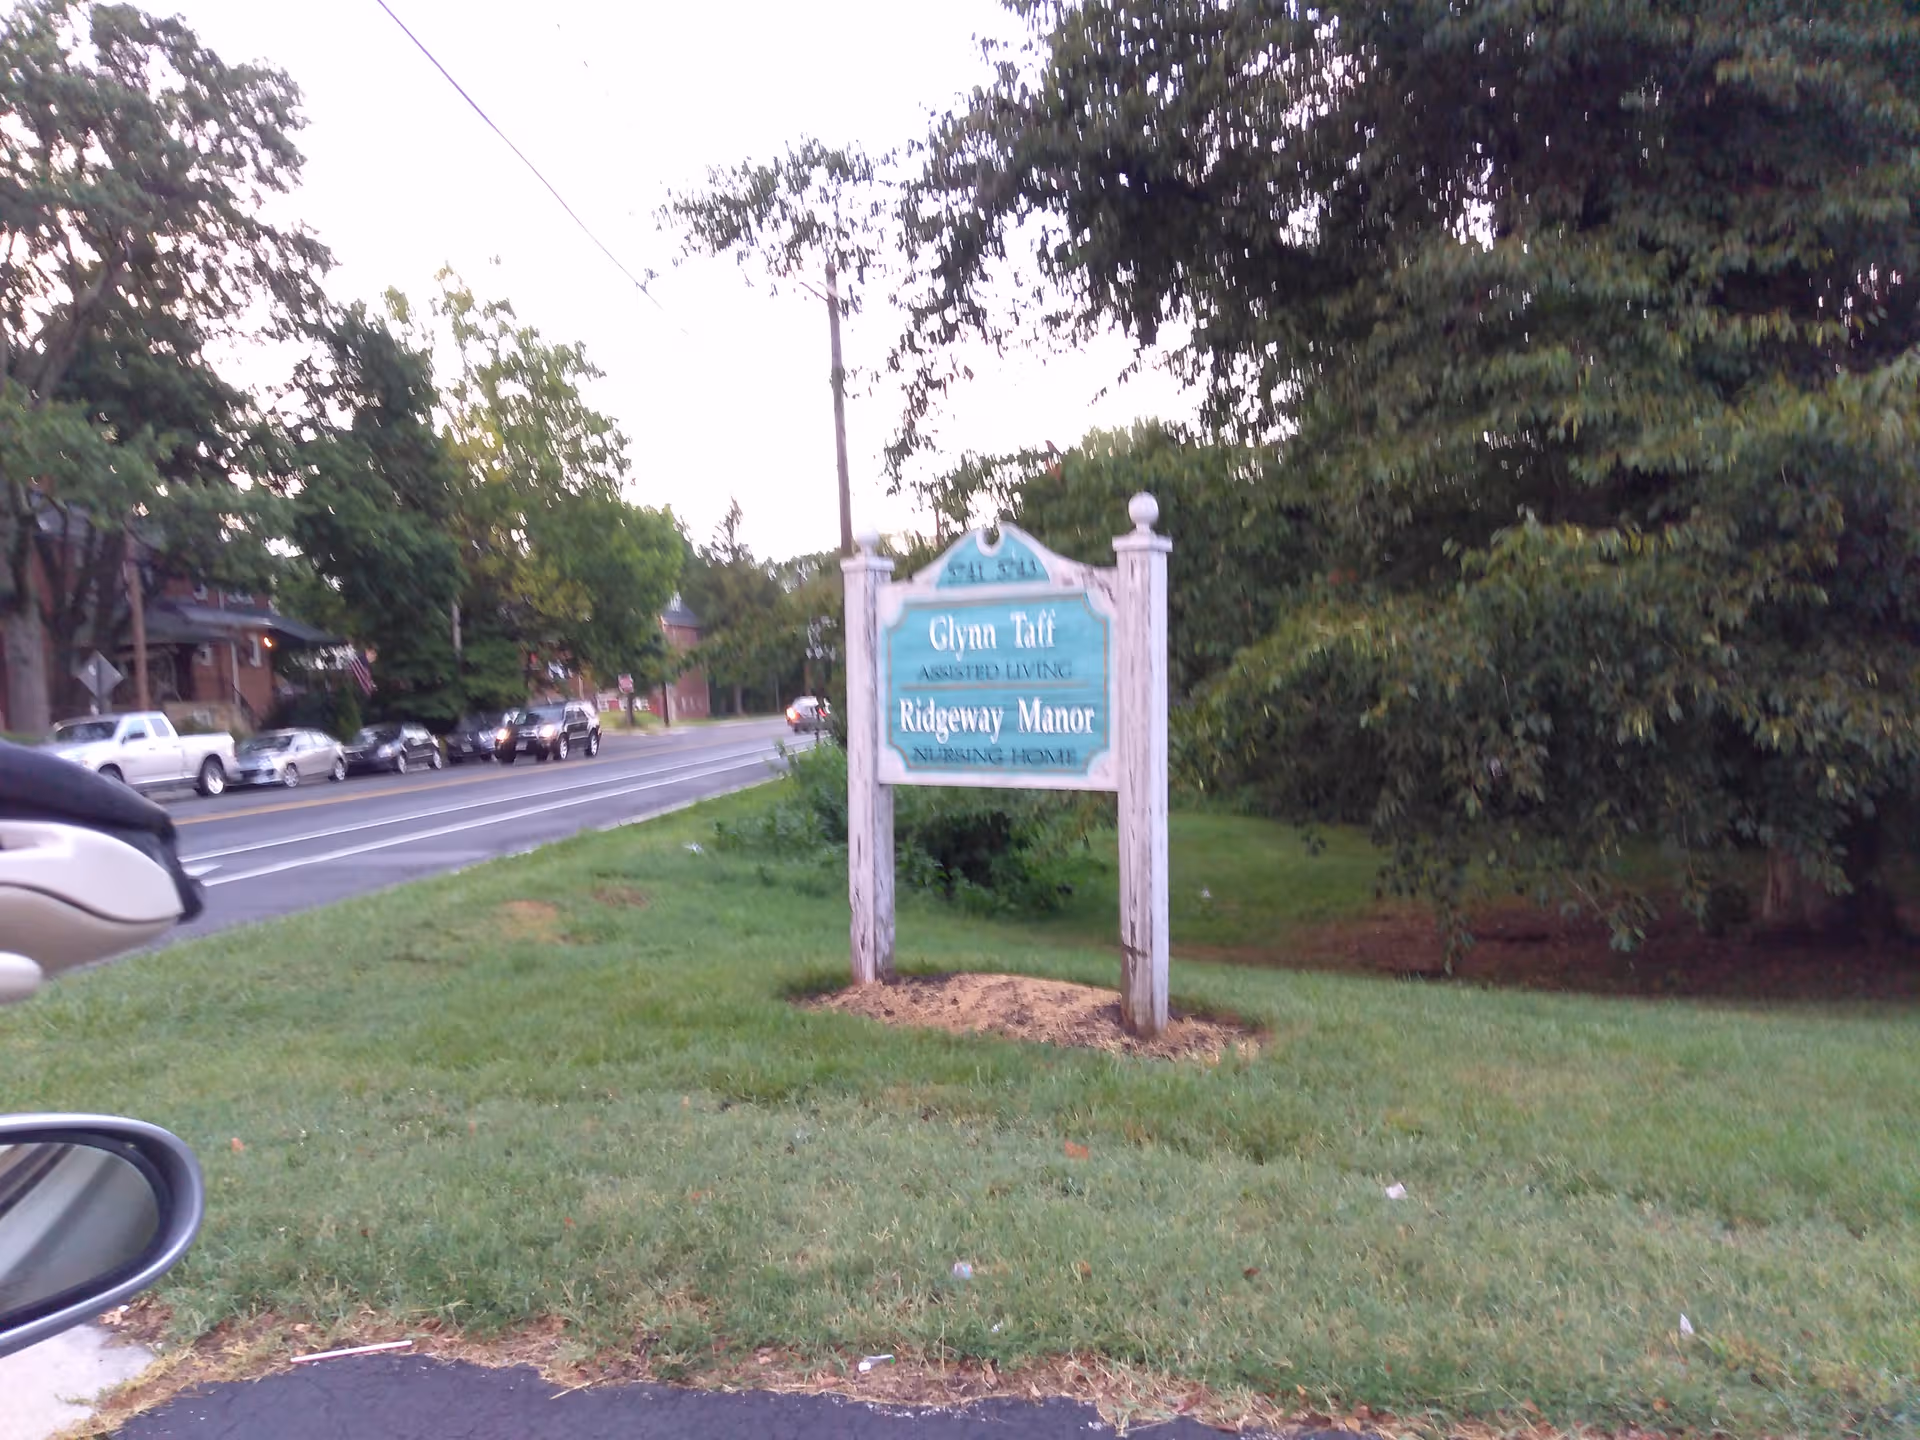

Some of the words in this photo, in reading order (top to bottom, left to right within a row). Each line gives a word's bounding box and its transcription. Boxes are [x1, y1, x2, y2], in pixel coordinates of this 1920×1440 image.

[929, 614, 997, 661] Glynn
[1010, 608, 1056, 648] Taff
[919, 663, 999, 681] ASSISTED
[1006, 660, 1072, 680] LIVING
[899, 697, 1004, 744] Ridgeway
[1017, 697, 1095, 734] Manor
[914, 746, 1001, 764] NURSING
[1011, 747, 1077, 767] HOME
